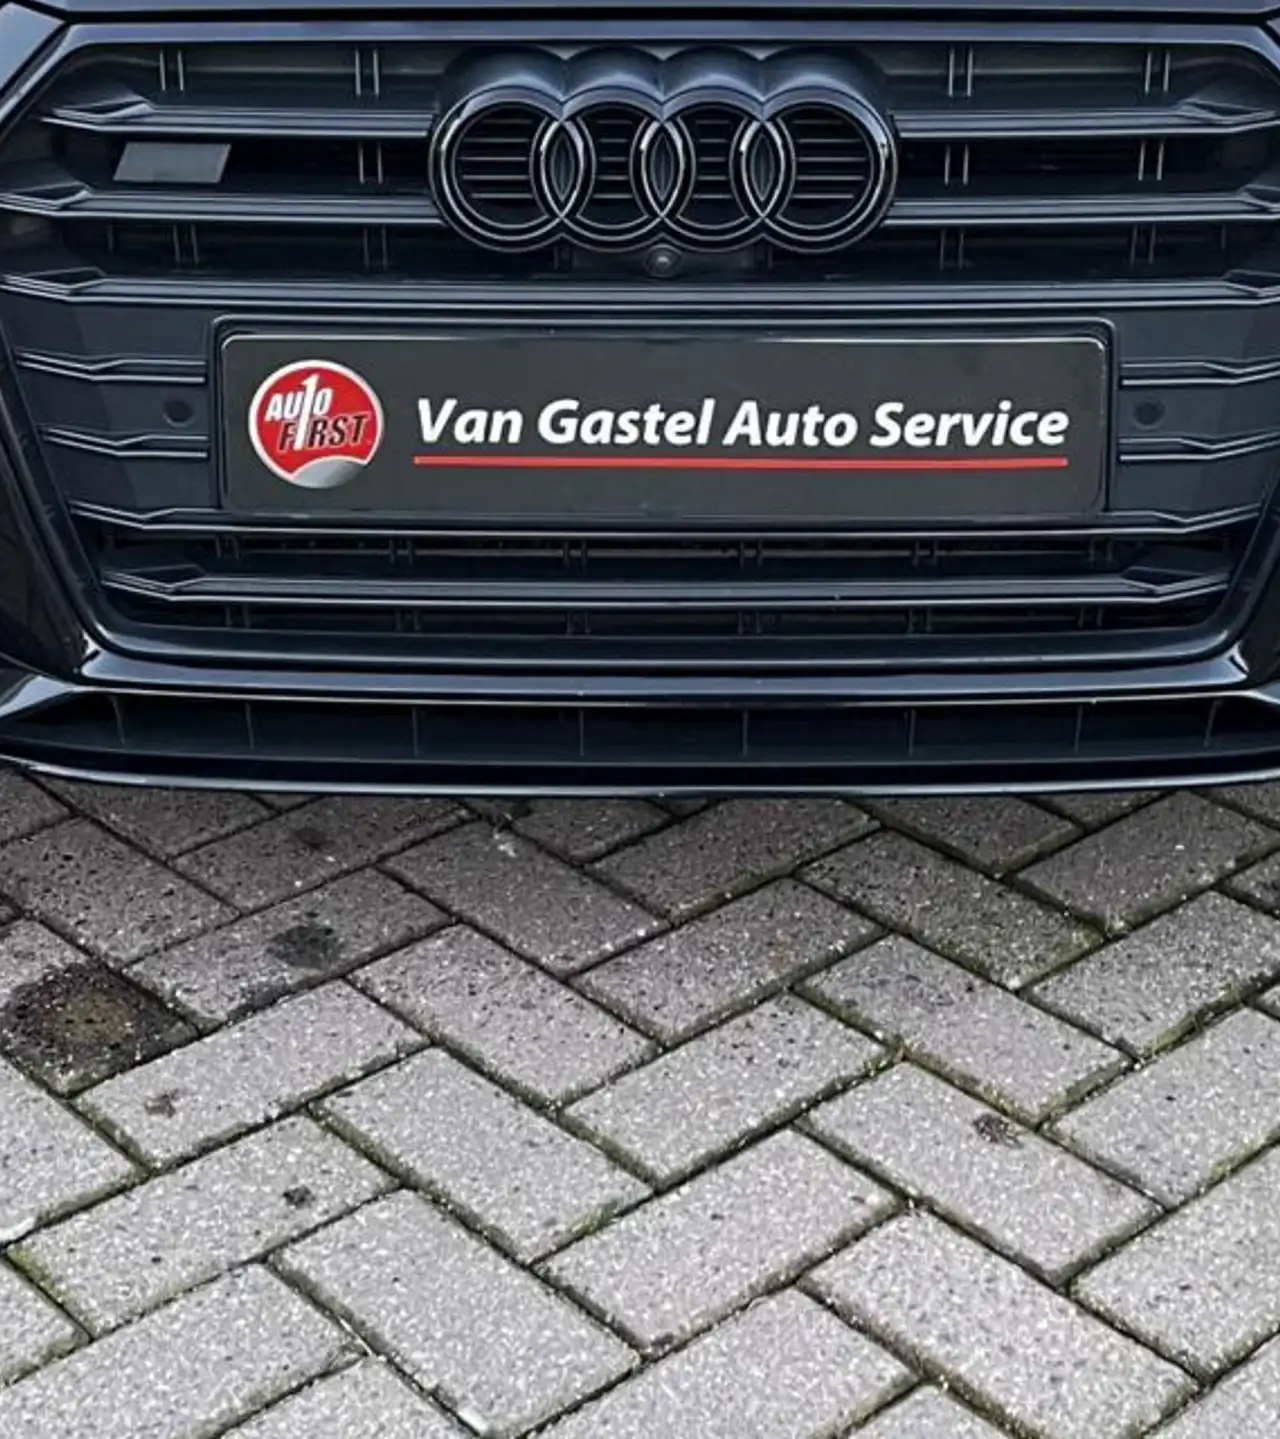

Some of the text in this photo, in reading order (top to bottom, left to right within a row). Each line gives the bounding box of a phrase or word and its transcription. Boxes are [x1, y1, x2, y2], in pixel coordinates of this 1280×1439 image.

[416, 398, 1070, 449] Van Gastel Auto Service
